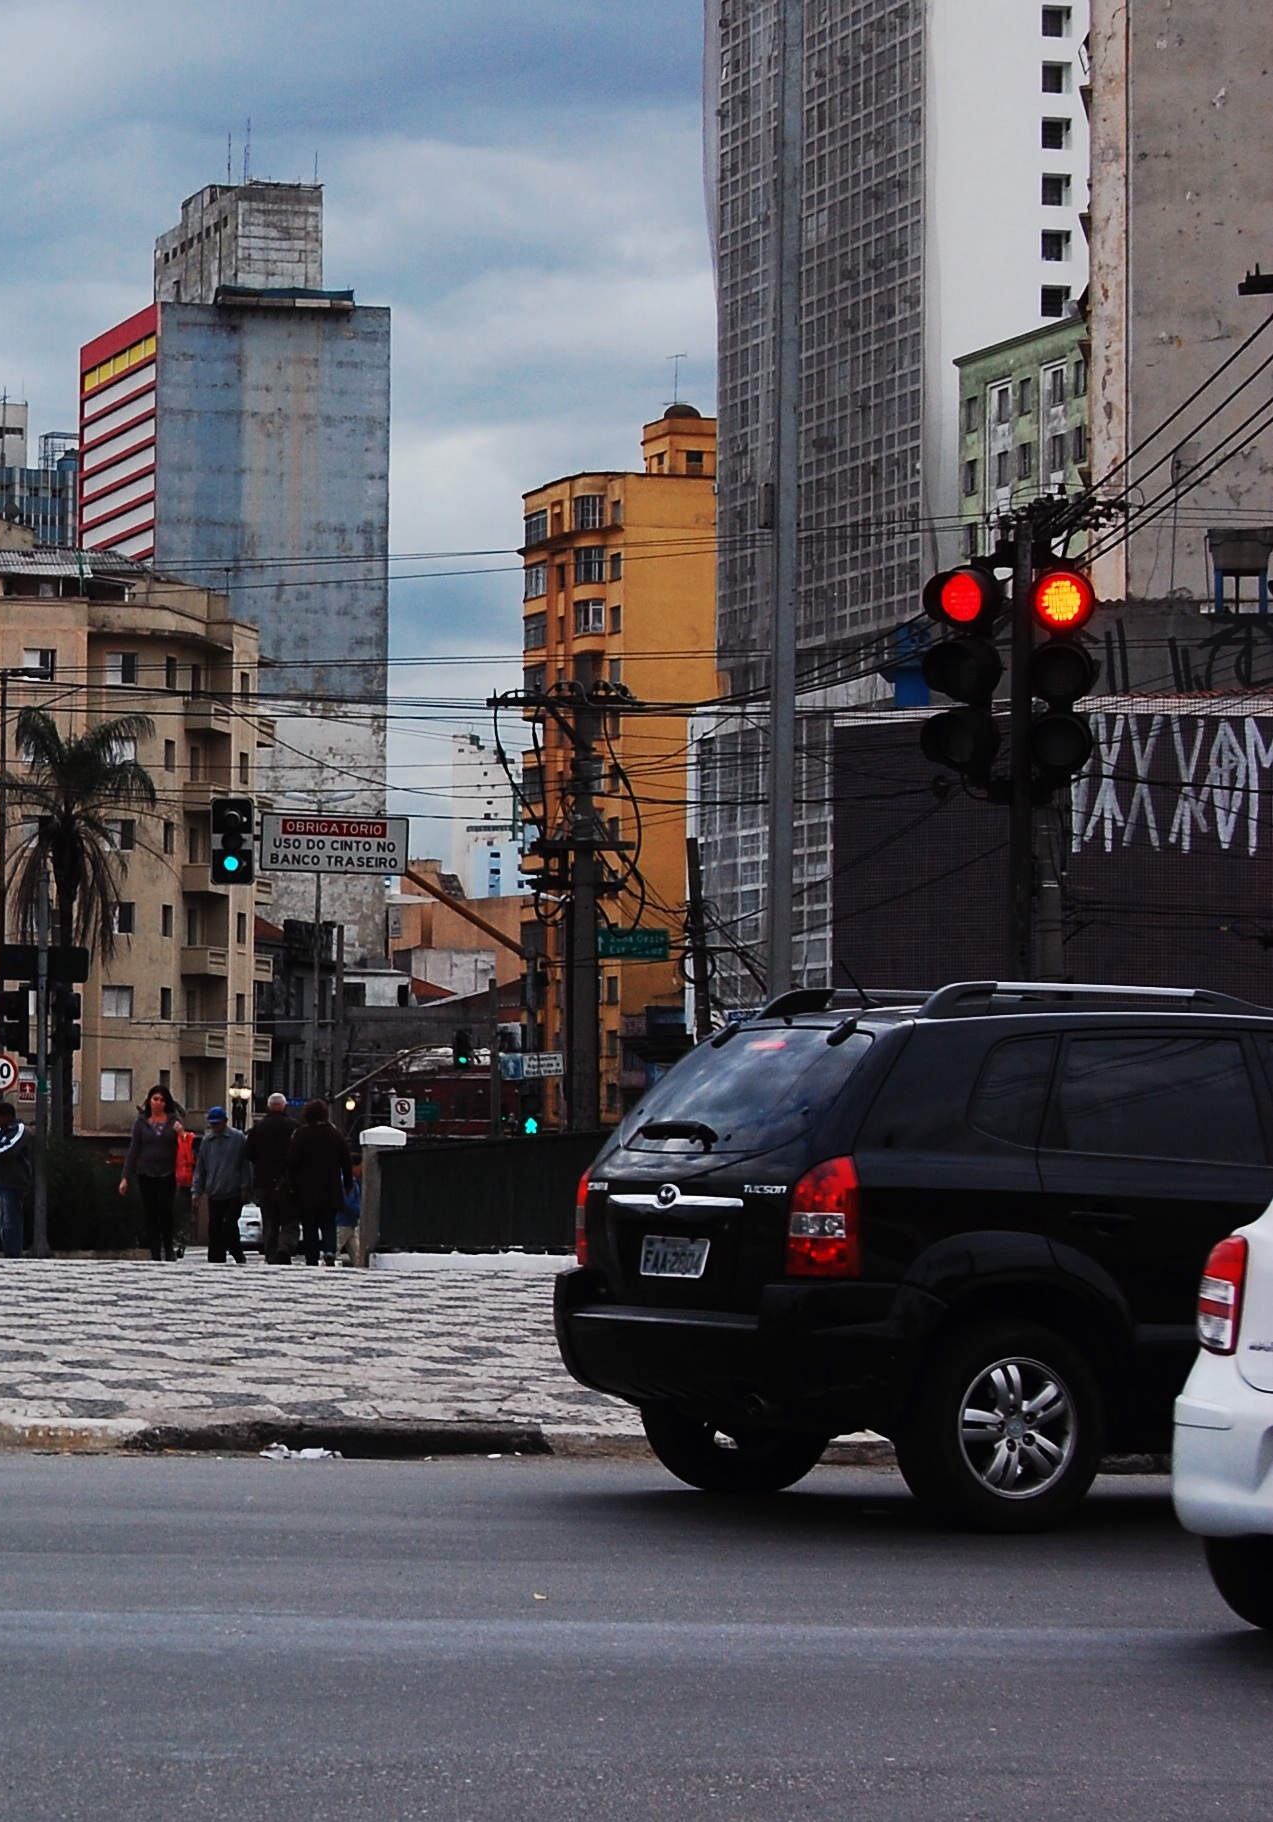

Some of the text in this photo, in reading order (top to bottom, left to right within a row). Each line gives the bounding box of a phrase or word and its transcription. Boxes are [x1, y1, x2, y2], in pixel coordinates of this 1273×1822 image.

[286, 821, 382, 835] OBRIGATÓRIO
[273, 838, 396, 853] USO DO CINTO NO
[270, 853, 398, 868] BANCO TRASEIRO
[743, 1184, 788, 1194] TUCSON
